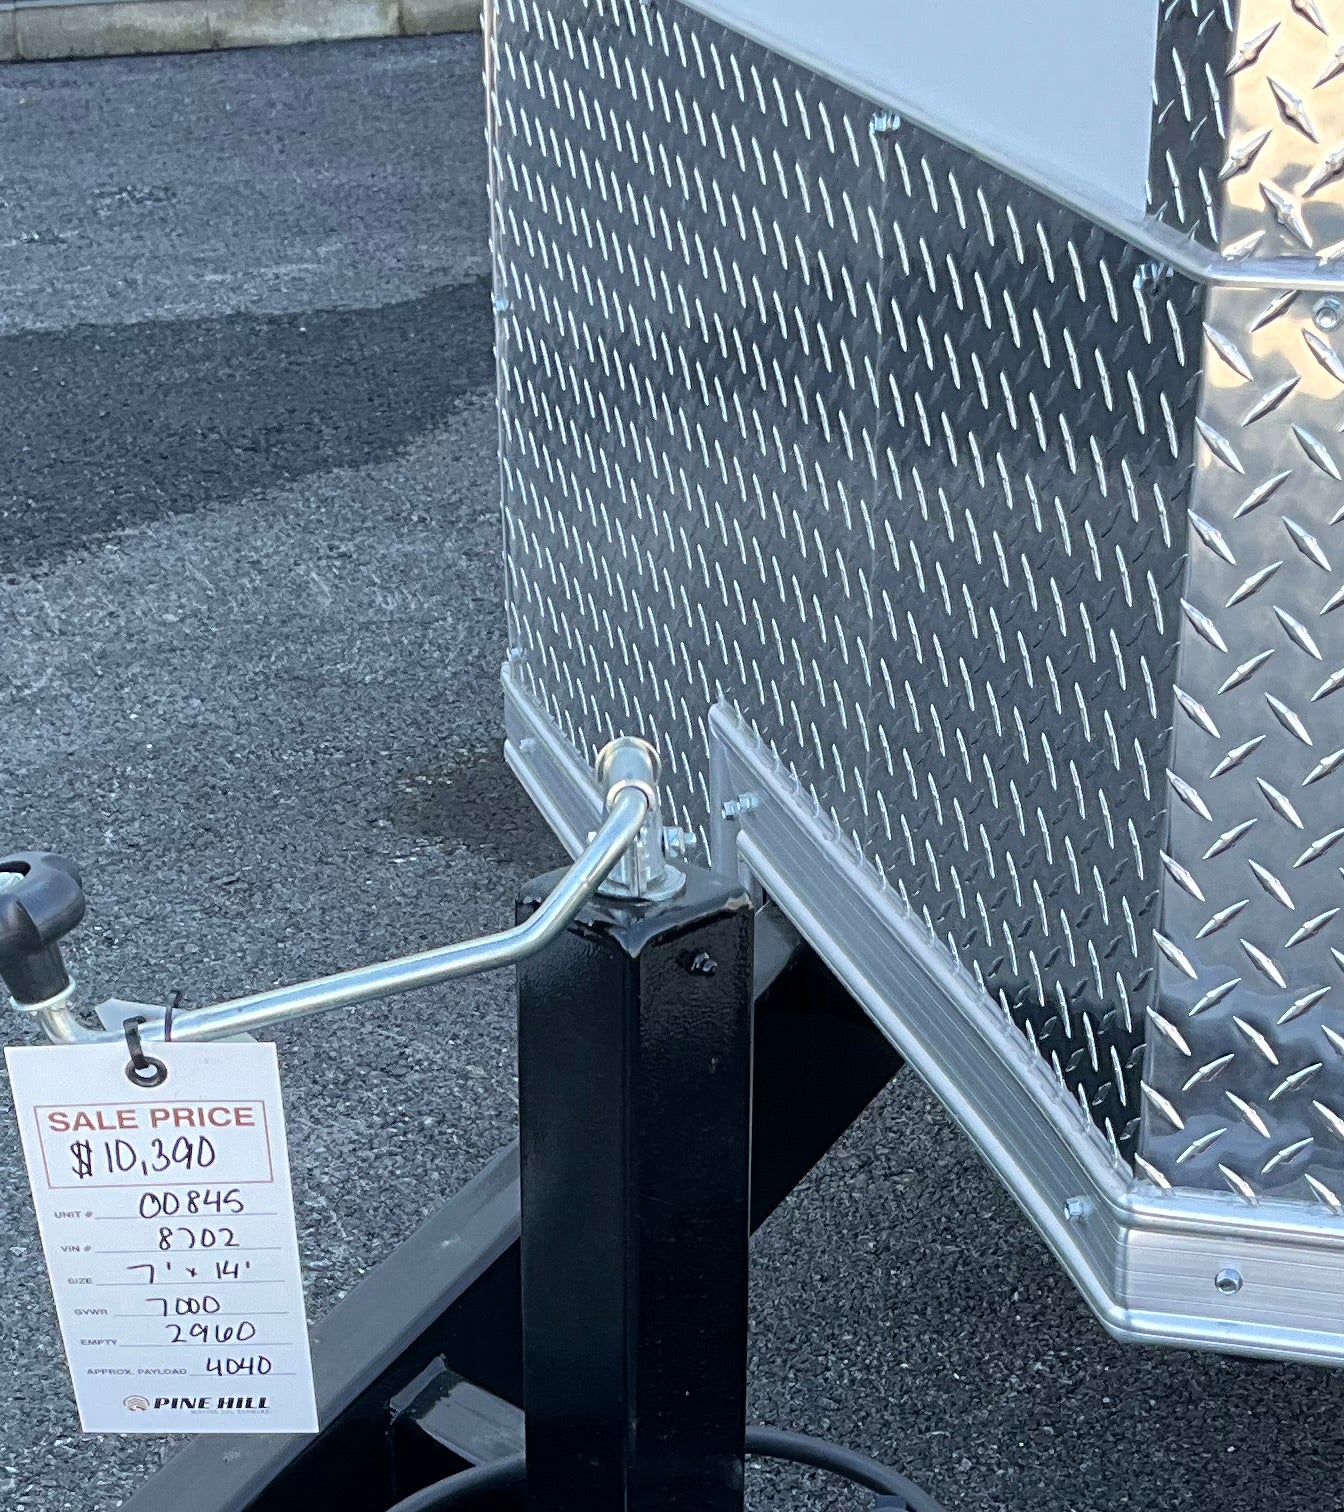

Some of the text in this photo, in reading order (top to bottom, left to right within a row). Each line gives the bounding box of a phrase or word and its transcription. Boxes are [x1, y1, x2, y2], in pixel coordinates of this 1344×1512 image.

[48, 1106, 256, 1132] SALE PRICE
[54, 1209, 82, 1219] UNIT
[139, 1188, 245, 1219] 00845
[60, 1245, 80, 1253] VIN
[67, 1277, 93, 1285] SIZE
[73, 1295, 221, 1316] GVWR 7000
[165, 1321, 256, 1343] 2960
[206, 1355, 272, 1376] 4040
[153, 1396, 270, 1409] PINE HILL
